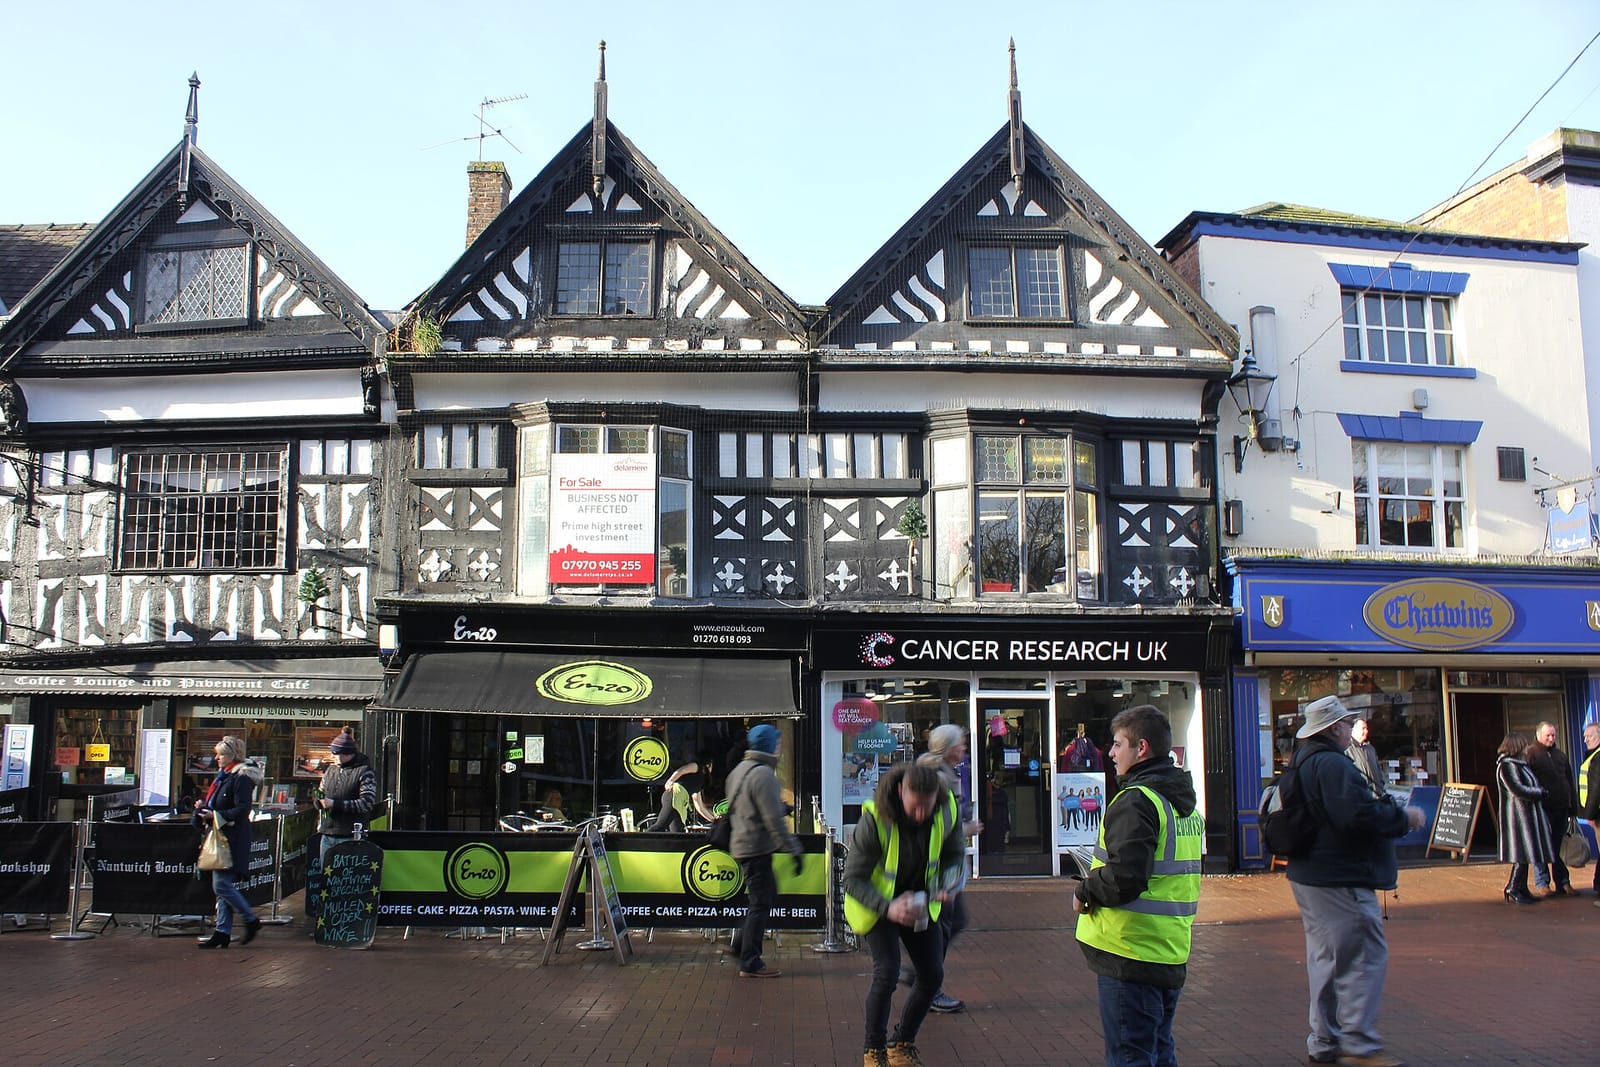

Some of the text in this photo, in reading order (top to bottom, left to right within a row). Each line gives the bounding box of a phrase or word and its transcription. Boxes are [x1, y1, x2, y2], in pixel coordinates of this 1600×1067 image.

[560, 478, 602, 487] For Sale
[568, 494, 638, 502] BUSINESS NOT
[578, 505, 628, 514] AFFECTED
[562, 522, 642, 532] Prime high street
[562, 560, 642, 570] 07970 945 255
[1384, 592, 1493, 634] Chatwins
[454, 616, 497, 642] Enzo
[693, 635, 718, 643] 01270
[720, 635, 735, 643] 618
[901, 640, 999, 660] CANCER
[1009, 640, 1129, 661] RESEARCH
[1136, 642, 1168, 661] UK
[14, 676, 310, 690] Coffee Lounge and Pavement Café
[564, 674, 633, 694] Enzo
[208, 704, 329, 718] Nantwich Book Shop
[634, 749, 662, 766] Enzo
[0, 861, 50, 875] ookshop
[97, 860, 150, 875] Nantwich
[333, 855, 370, 868] BATTLE
[342, 867, 354, 876] OF
[461, 859, 496, 880] Enzo
[699, 861, 735, 881] Enzo
[327, 874, 372, 886] NANTWICH
[331, 885, 364, 897] SPECIAL
[324, 899, 364, 918] MULLED
[417, 905, 444, 915] CAKE
[449, 906, 478, 915] PIZZA
[484, 906, 515, 916] PASTA
[520, 906, 546, 916] WINE
[552, 906, 576, 916] BR
[620, 906, 816, 918] OFFEE CAKE PIZZA PAST INE BEER
[331, 912, 362, 926] CIDER
[324, 927, 359, 942] WINE
